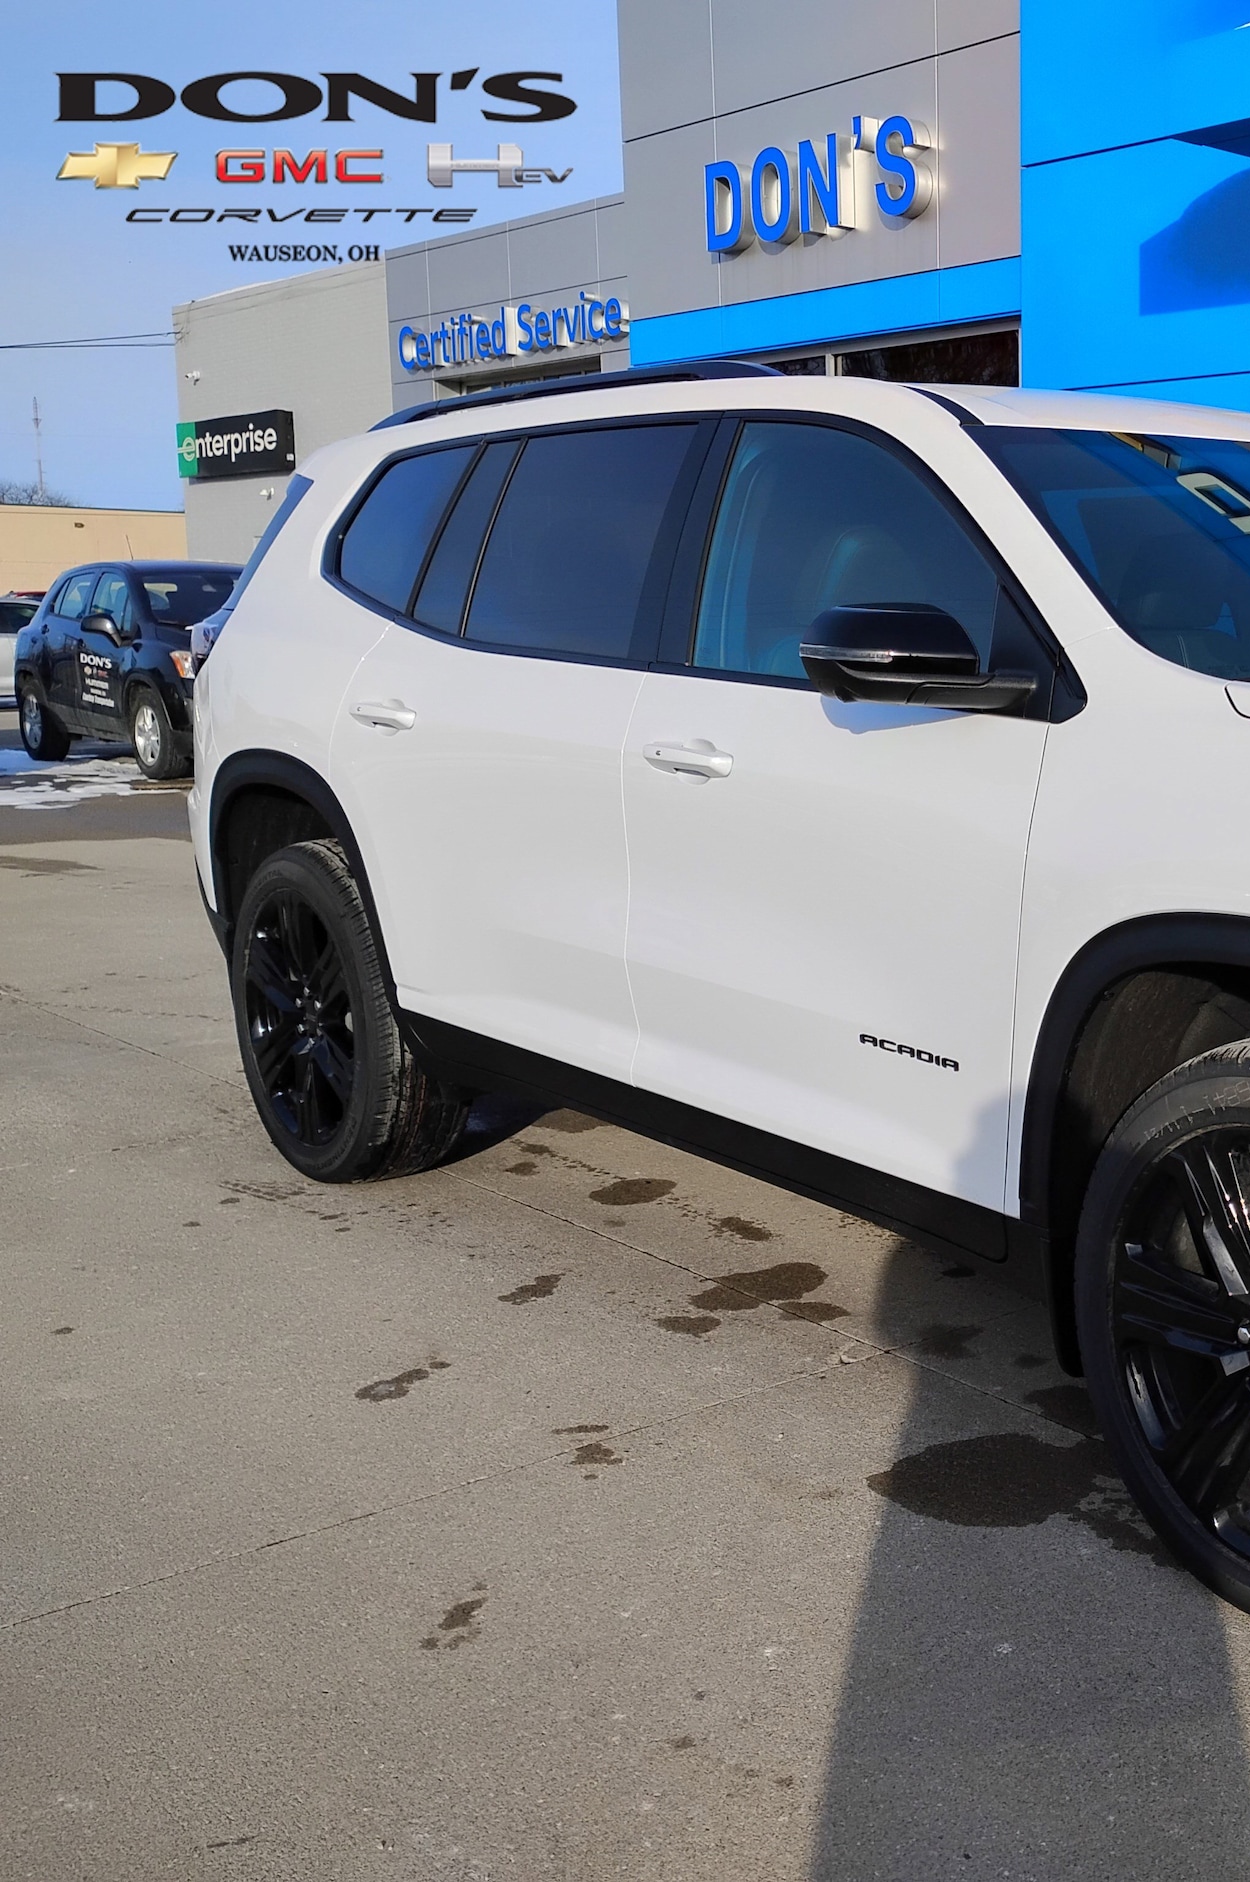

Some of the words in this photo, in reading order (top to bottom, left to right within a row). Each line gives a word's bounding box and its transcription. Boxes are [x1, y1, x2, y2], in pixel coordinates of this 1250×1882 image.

[704, 115, 917, 252] DON'S
[398, 306, 507, 370] Certified
[516, 291, 622, 351] Service
[178, 422, 277, 463] enterprise
[80, 653, 112, 669] DON'S
[859, 1033, 959, 1072] ACADIA
